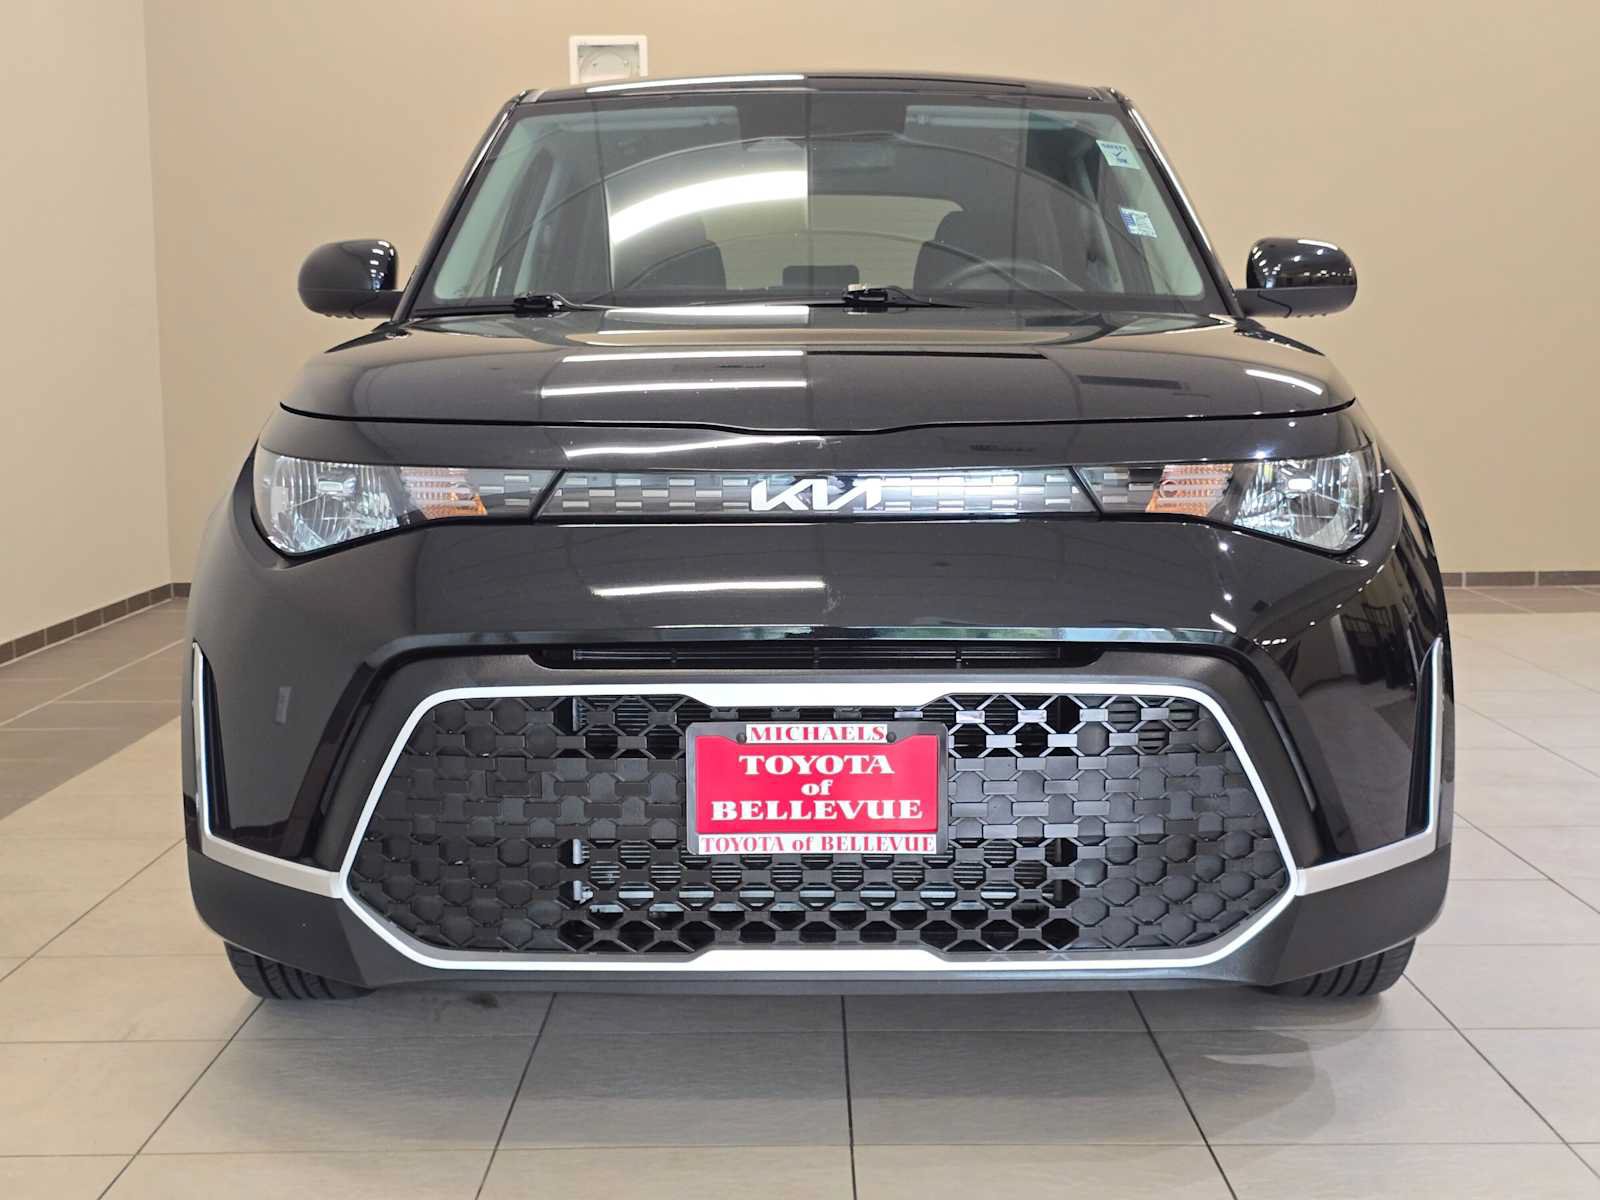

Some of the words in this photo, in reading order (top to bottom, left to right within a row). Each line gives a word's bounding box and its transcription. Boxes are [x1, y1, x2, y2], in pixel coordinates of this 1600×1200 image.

[751, 478, 881, 510] KIA
[750, 726, 885, 741] MICHAELS
[738, 754, 895, 775] TOYOTA
[801, 779, 833, 796] of
[711, 800, 923, 821] BELLEVUE
[702, 837, 785, 851] TOYOTA
[791, 836, 815, 851] of
[821, 836, 935, 851] BELLEVUE
